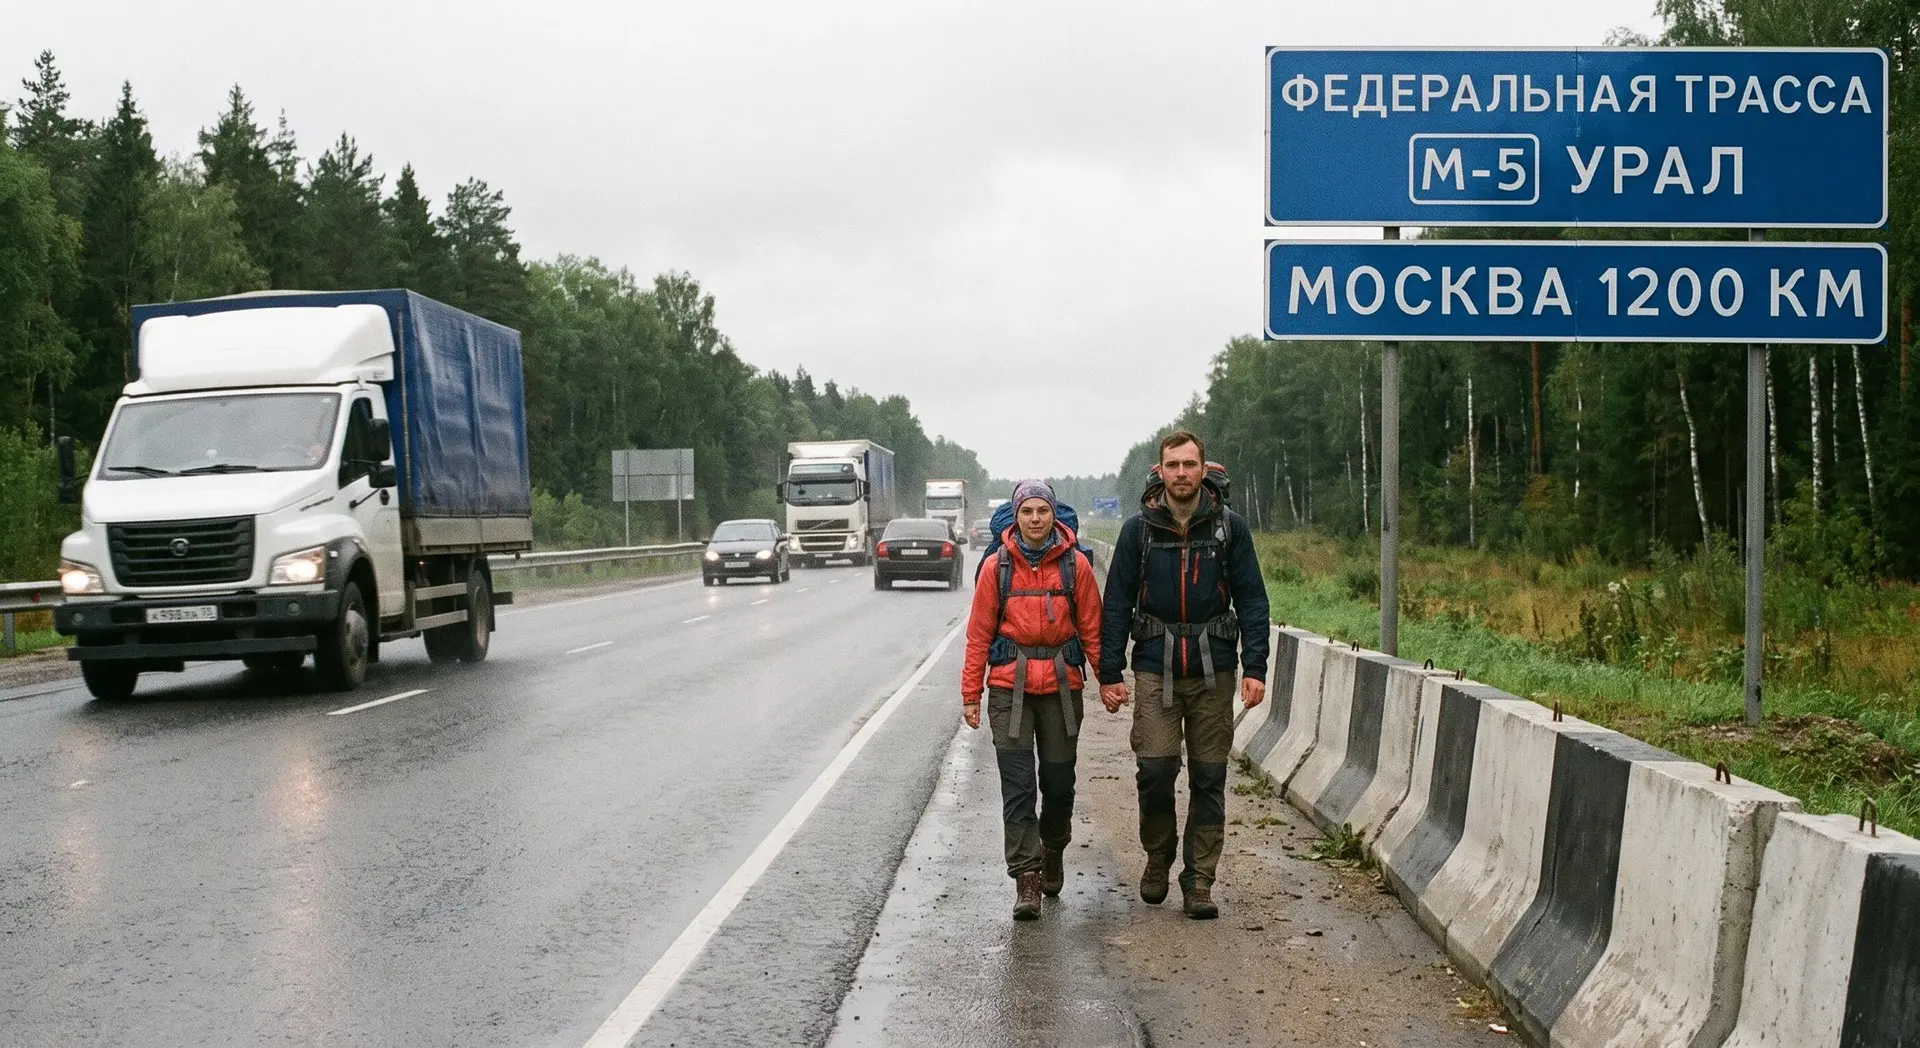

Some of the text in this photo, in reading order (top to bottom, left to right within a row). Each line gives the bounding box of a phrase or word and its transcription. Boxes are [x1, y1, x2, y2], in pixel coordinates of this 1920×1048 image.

[1281, 73, 1872, 119] ФЕДЕРАЛЬНАЯ ТРАССА
[1421, 145, 1744, 195] М-5 УРАЛ
[1288, 265, 1865, 318] МОСКВА 1200 КМ
